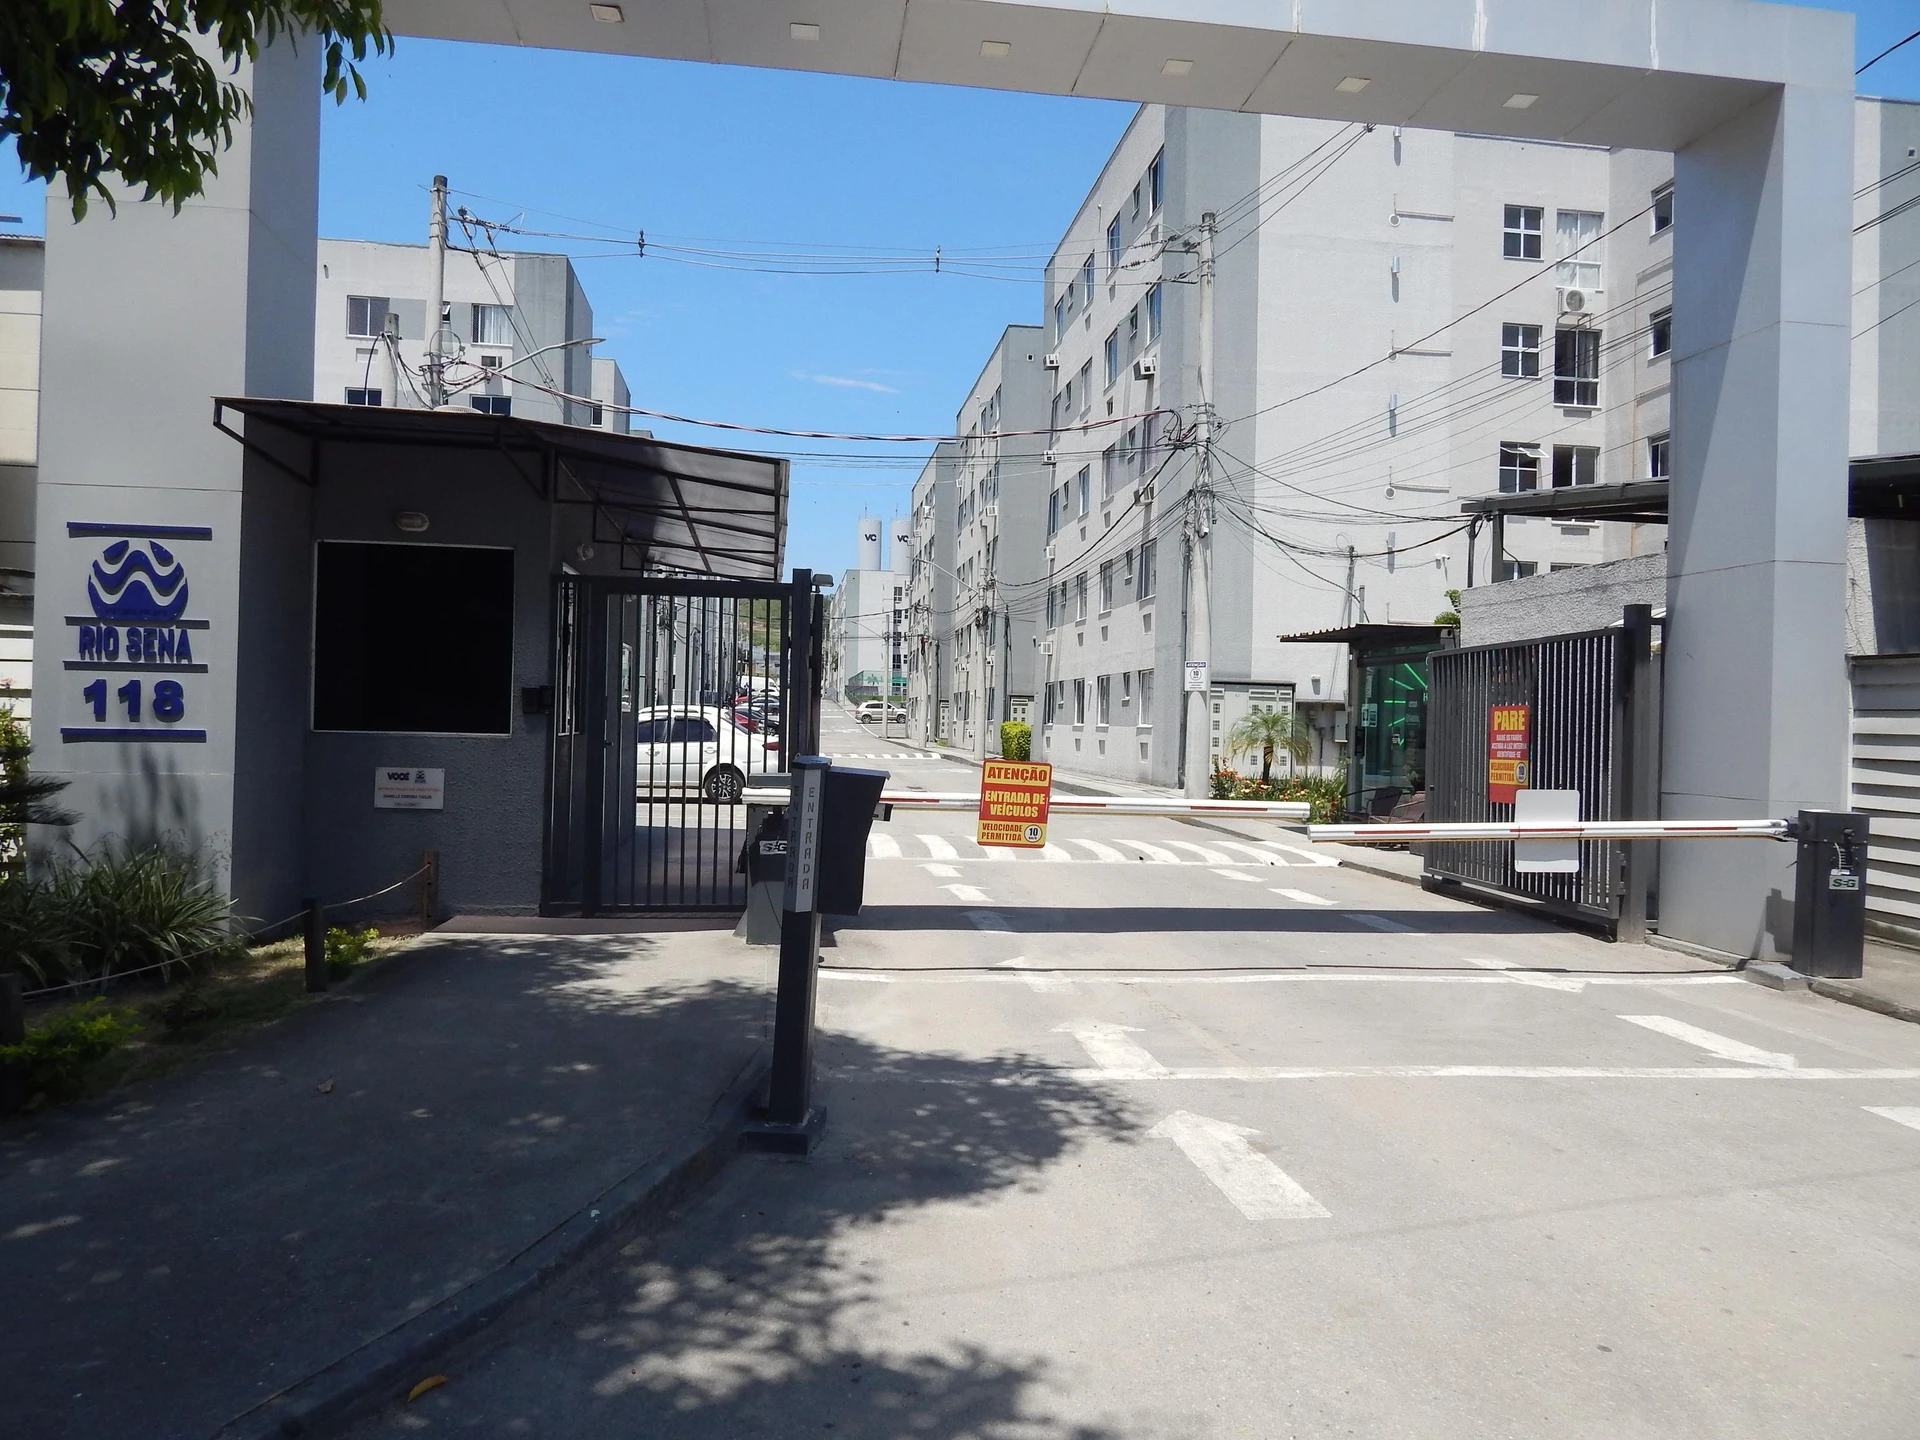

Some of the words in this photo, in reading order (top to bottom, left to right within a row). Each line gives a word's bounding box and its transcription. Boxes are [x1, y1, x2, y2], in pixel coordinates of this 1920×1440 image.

[865, 534, 877, 542] VC
[897, 535, 909, 543] VC
[79, 626, 119, 660] RIO
[126, 627, 192, 662] SENA
[83, 679, 184, 721] 118
[1494, 710, 1525, 730] PARE
[987, 766, 1047, 783] ATENÇÃO
[1491, 772, 1514, 781] PERMITIDA
[985, 790, 1031, 804] ENTRADA
[1032, 793, 1046, 804] DE
[990, 803, 1038, 817] VEÍCULOS
[982, 823, 1022, 832] VELOCIDADE
[1029, 827, 1039, 836] 10
[802, 787, 815, 890] ENTRADA
[981, 832, 1022, 841] PERMITIDA
